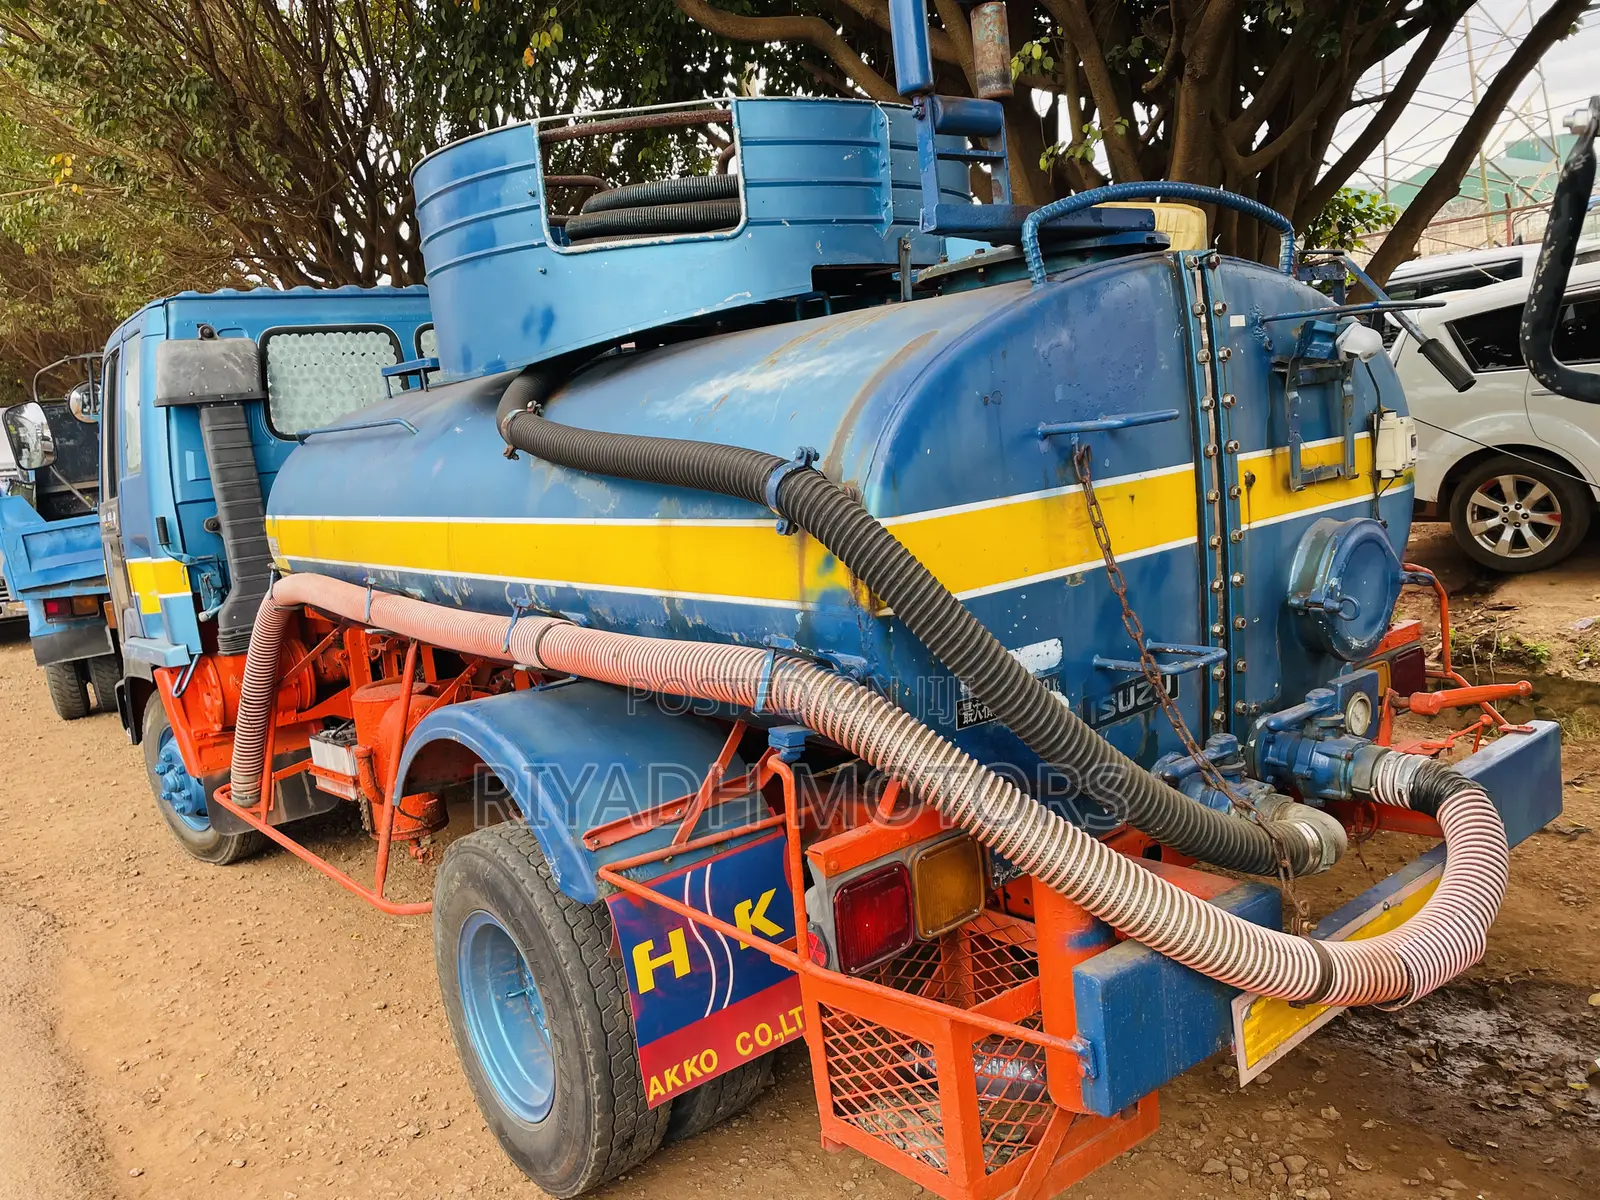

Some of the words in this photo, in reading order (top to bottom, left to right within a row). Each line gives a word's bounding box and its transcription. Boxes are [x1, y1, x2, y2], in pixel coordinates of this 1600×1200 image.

[632, 927, 691, 995] H
[733, 888, 784, 950] K
[649, 1048, 719, 1102] AKKO
